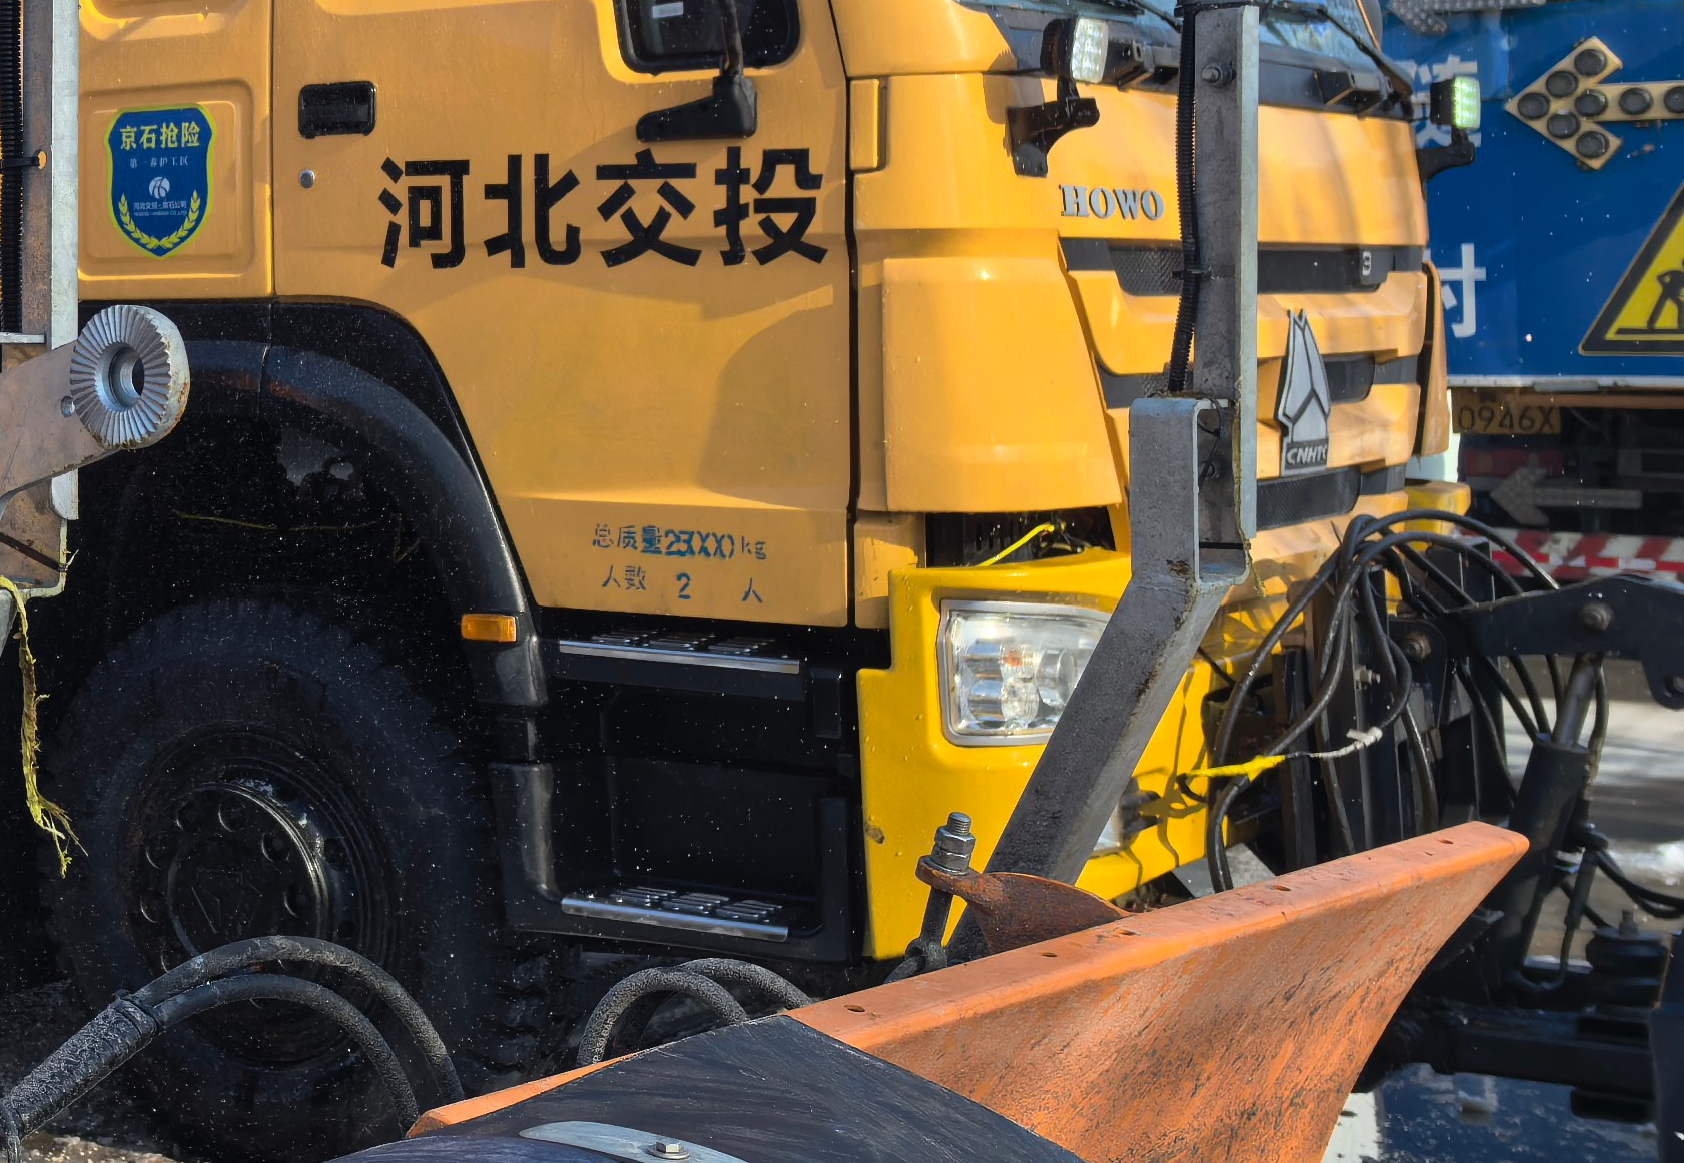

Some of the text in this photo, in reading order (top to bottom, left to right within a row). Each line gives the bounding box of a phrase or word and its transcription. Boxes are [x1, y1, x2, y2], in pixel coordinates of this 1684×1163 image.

[120, 121, 200, 150] 京石抢险
[378, 146, 828, 269] 河北交投
[1059, 184, 1164, 221] HOWO
[602, 564, 763, 603] 人数 2 人
